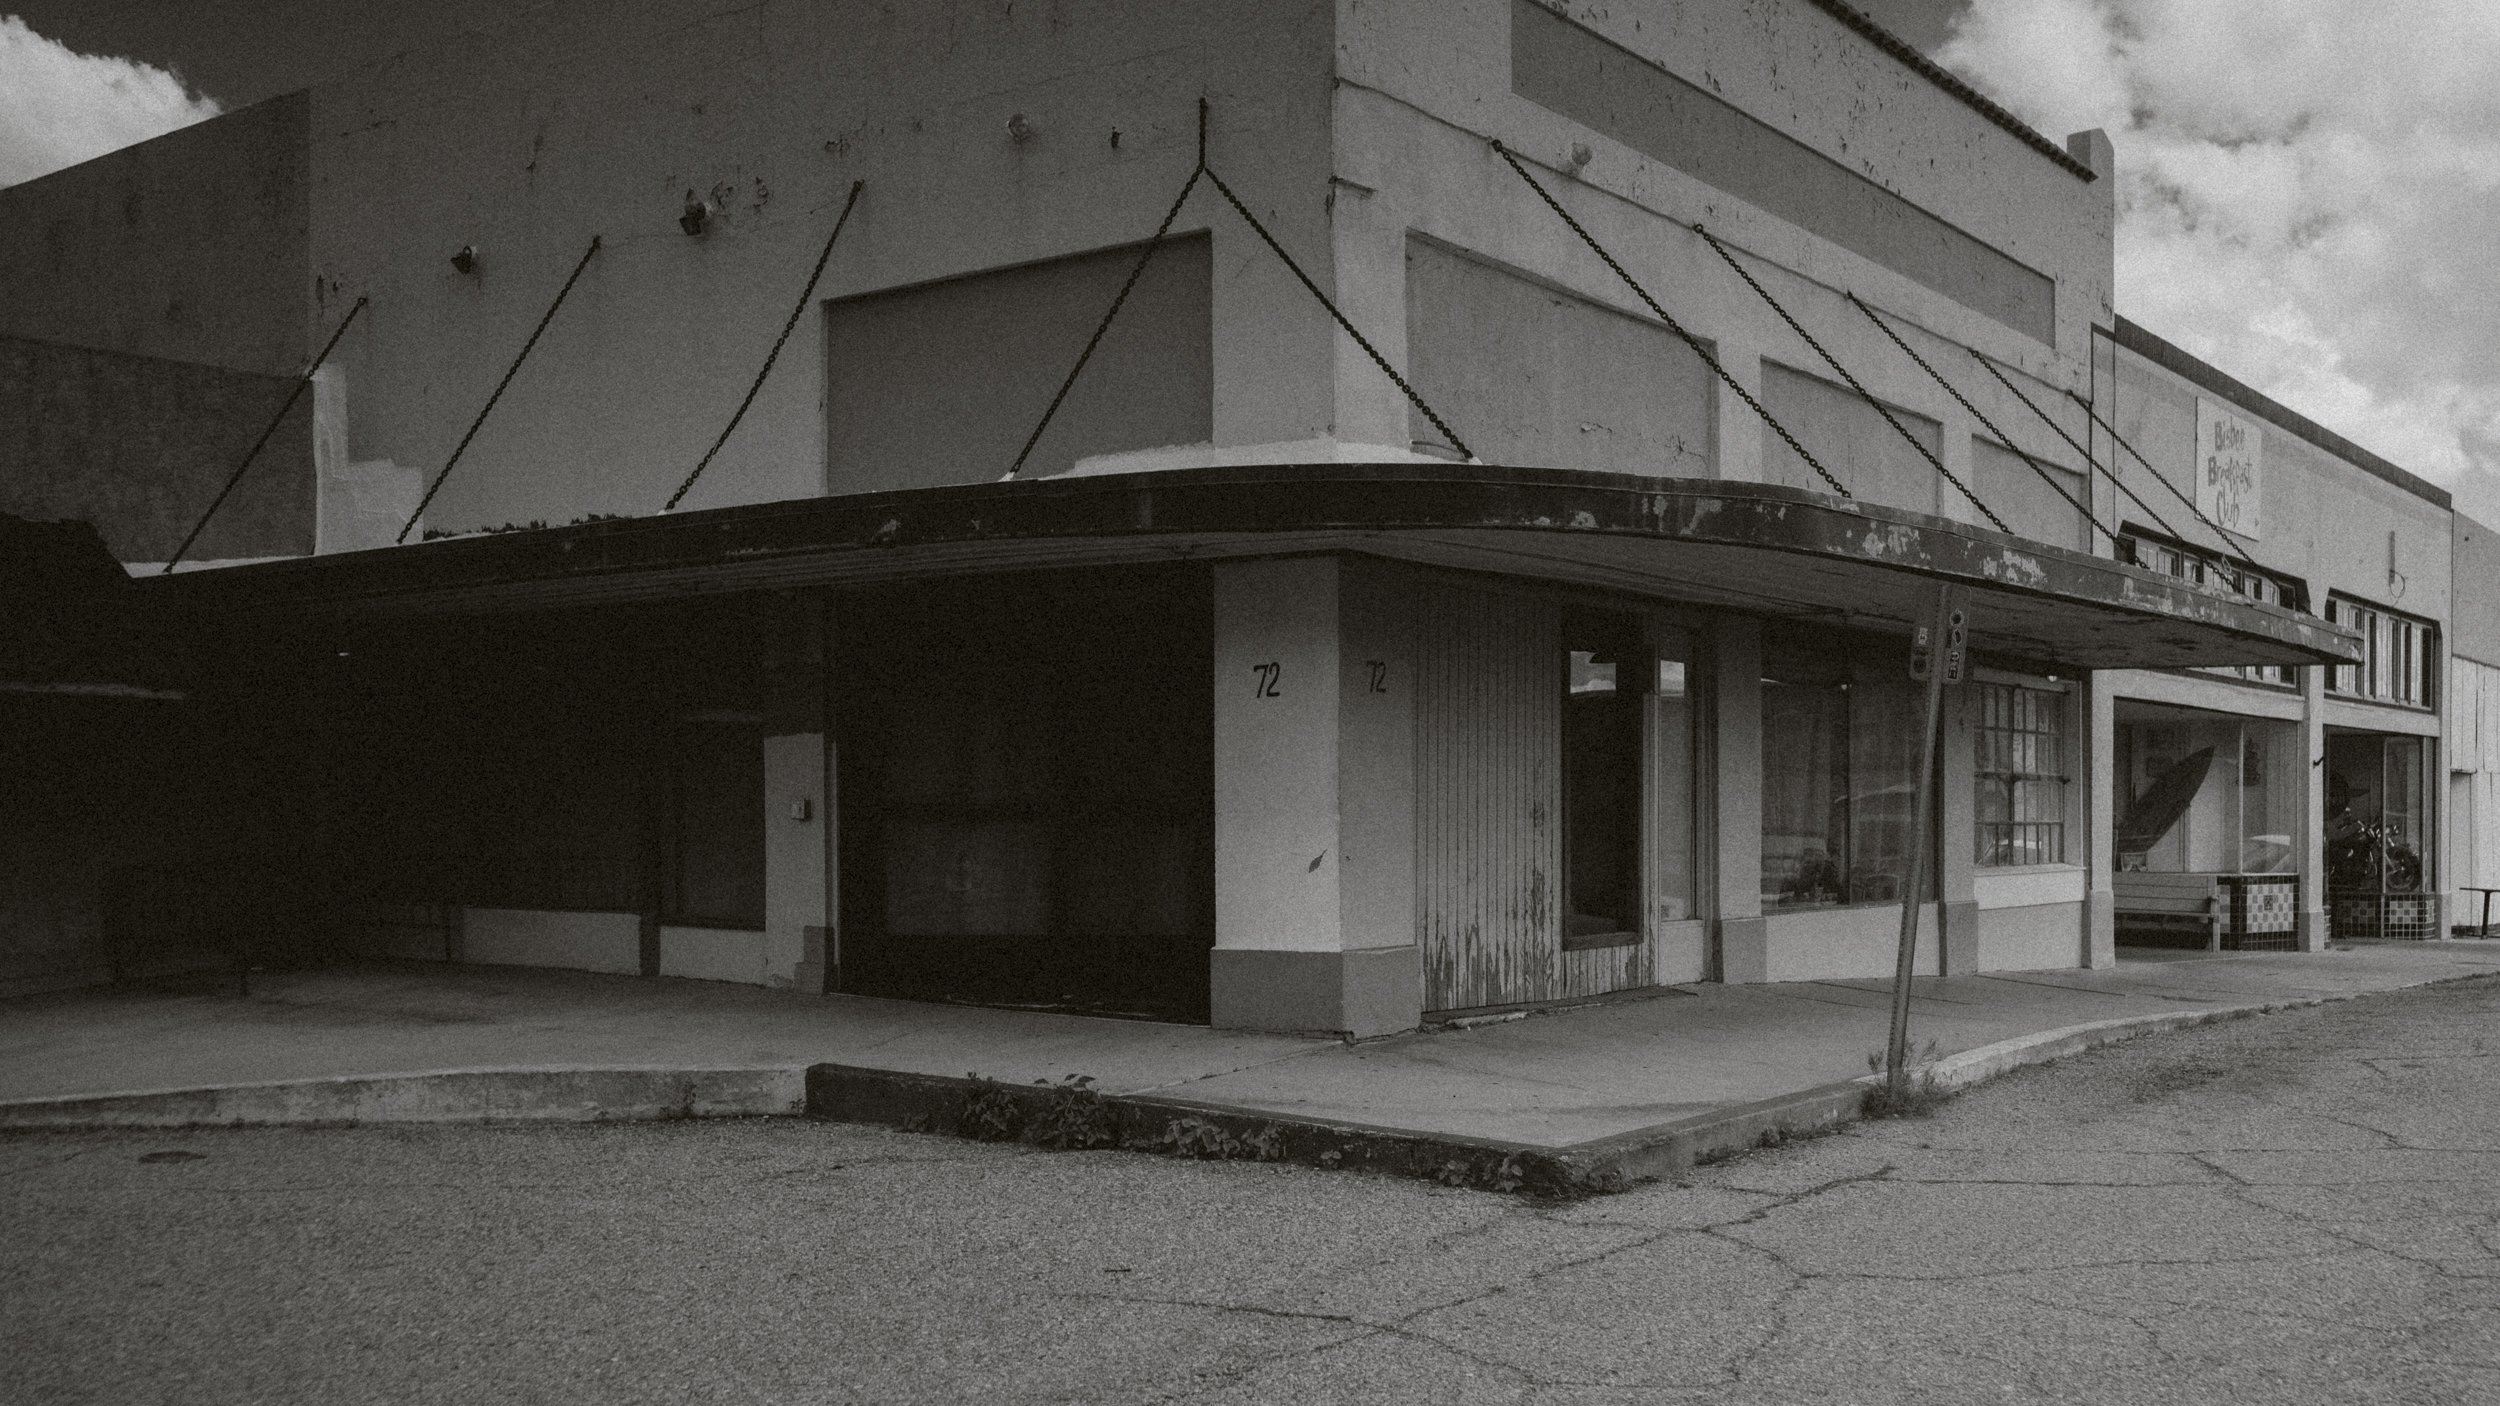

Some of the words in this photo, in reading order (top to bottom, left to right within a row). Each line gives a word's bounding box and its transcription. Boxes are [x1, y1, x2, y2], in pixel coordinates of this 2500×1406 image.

[2214, 416, 2246, 451] Bisbee
[2207, 454, 2253, 496] Breakfast
[2216, 487, 2240, 529] Club
[1253, 661, 1281, 698] 72
[1366, 660, 1387, 694] 72
